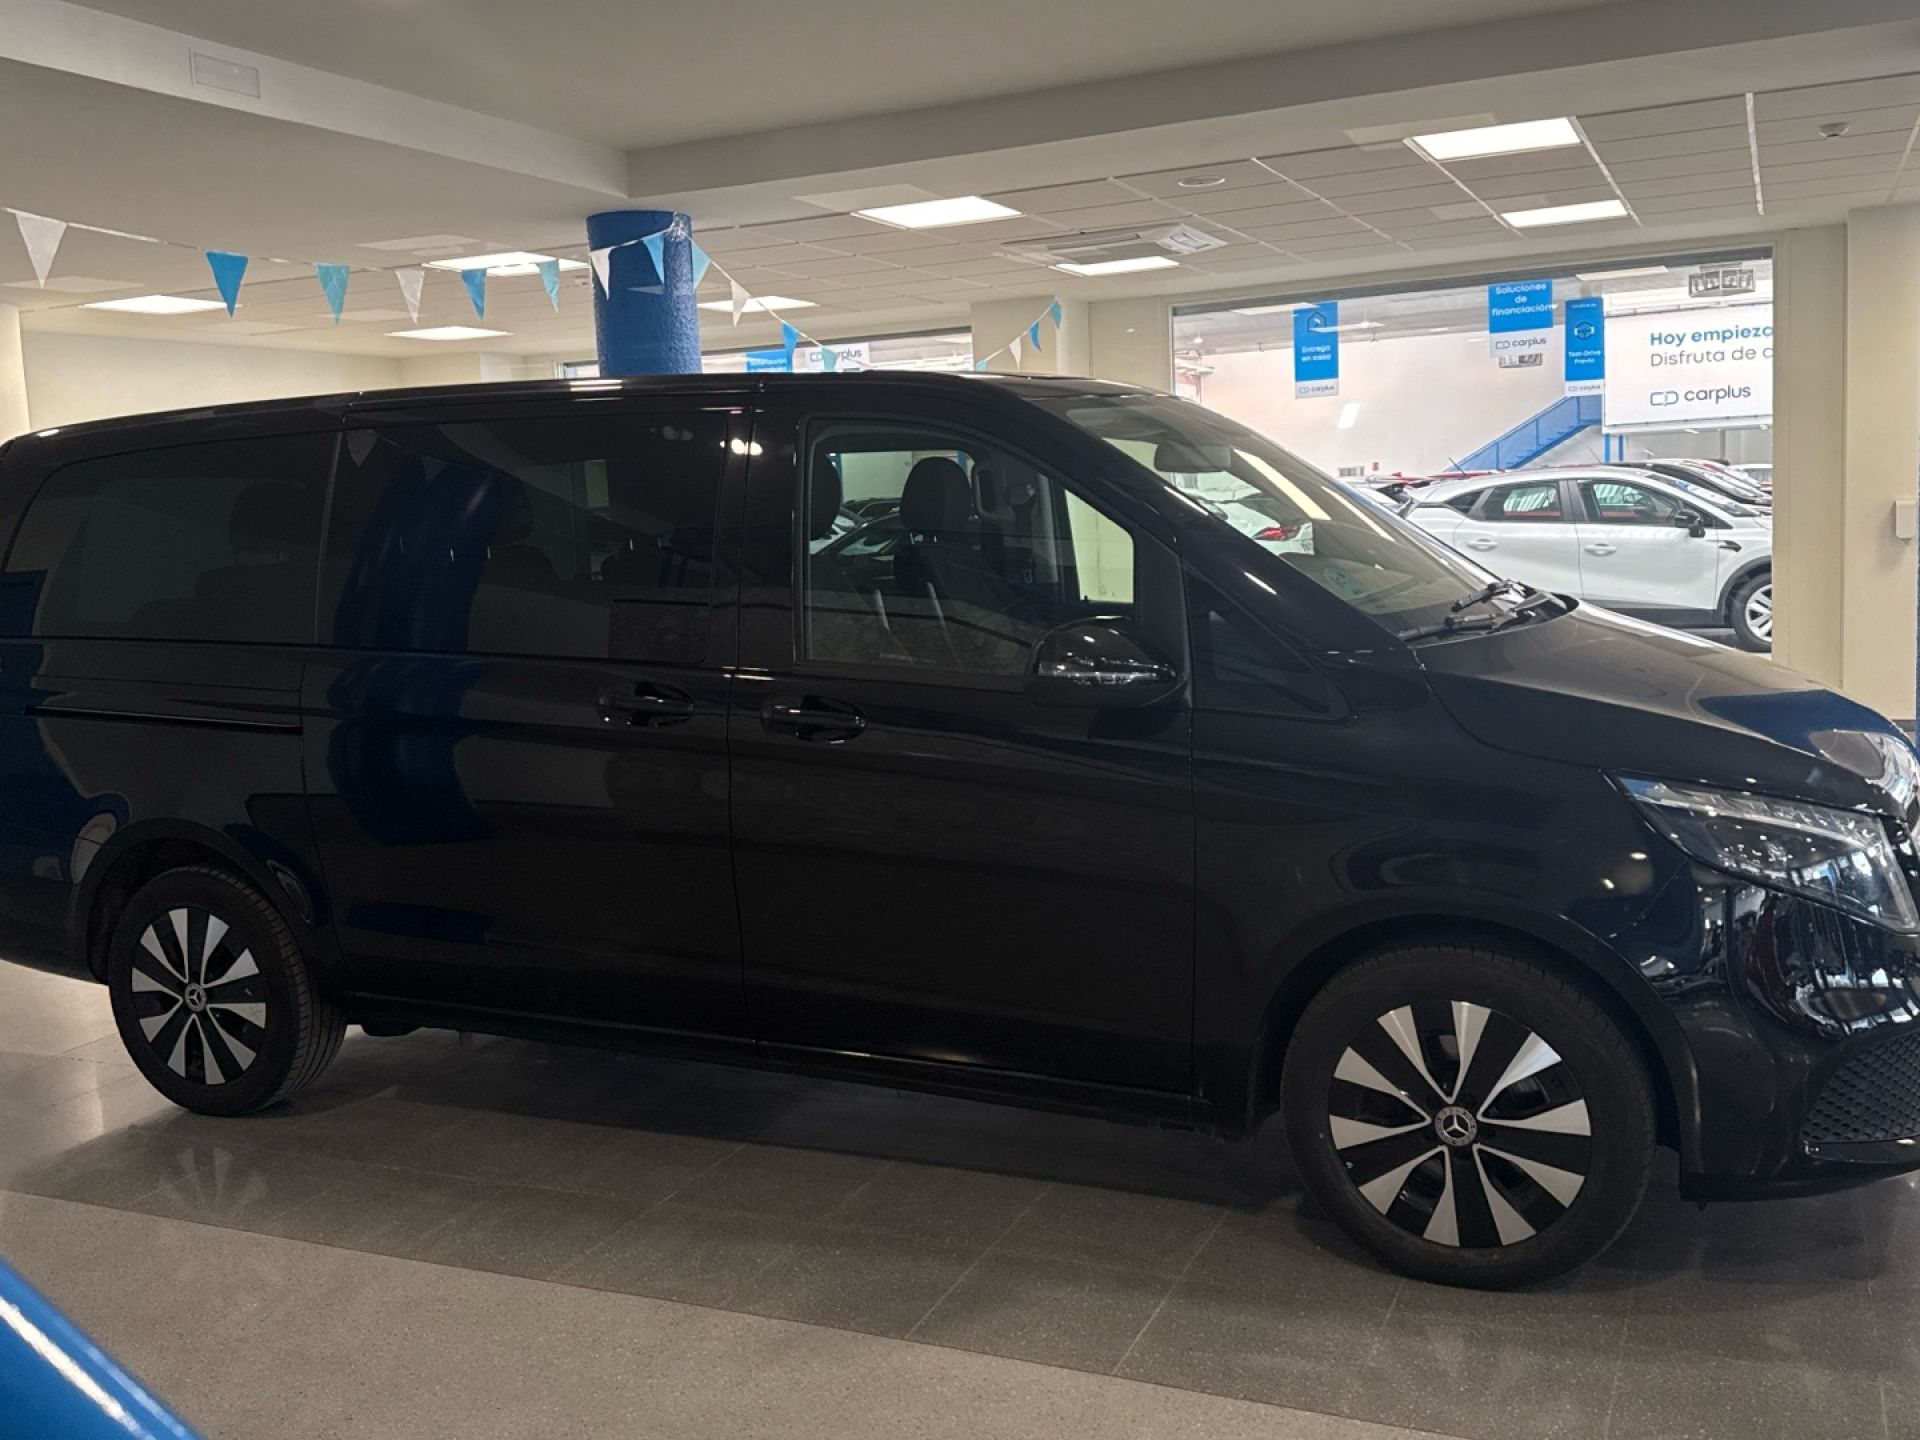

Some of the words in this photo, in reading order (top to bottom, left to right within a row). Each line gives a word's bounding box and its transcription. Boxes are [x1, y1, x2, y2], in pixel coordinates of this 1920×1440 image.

[1495, 283, 1547, 295] Soluciones
[1514, 295, 1528, 304] de
[1491, 303, 1552, 317] financiación
[1512, 336, 1547, 348] carplus
[1650, 332, 1686, 347] Hoy
[1650, 350, 1725, 367] Disfruta
[1731, 346, 1757, 360] de
[1684, 384, 1752, 404] carplus
